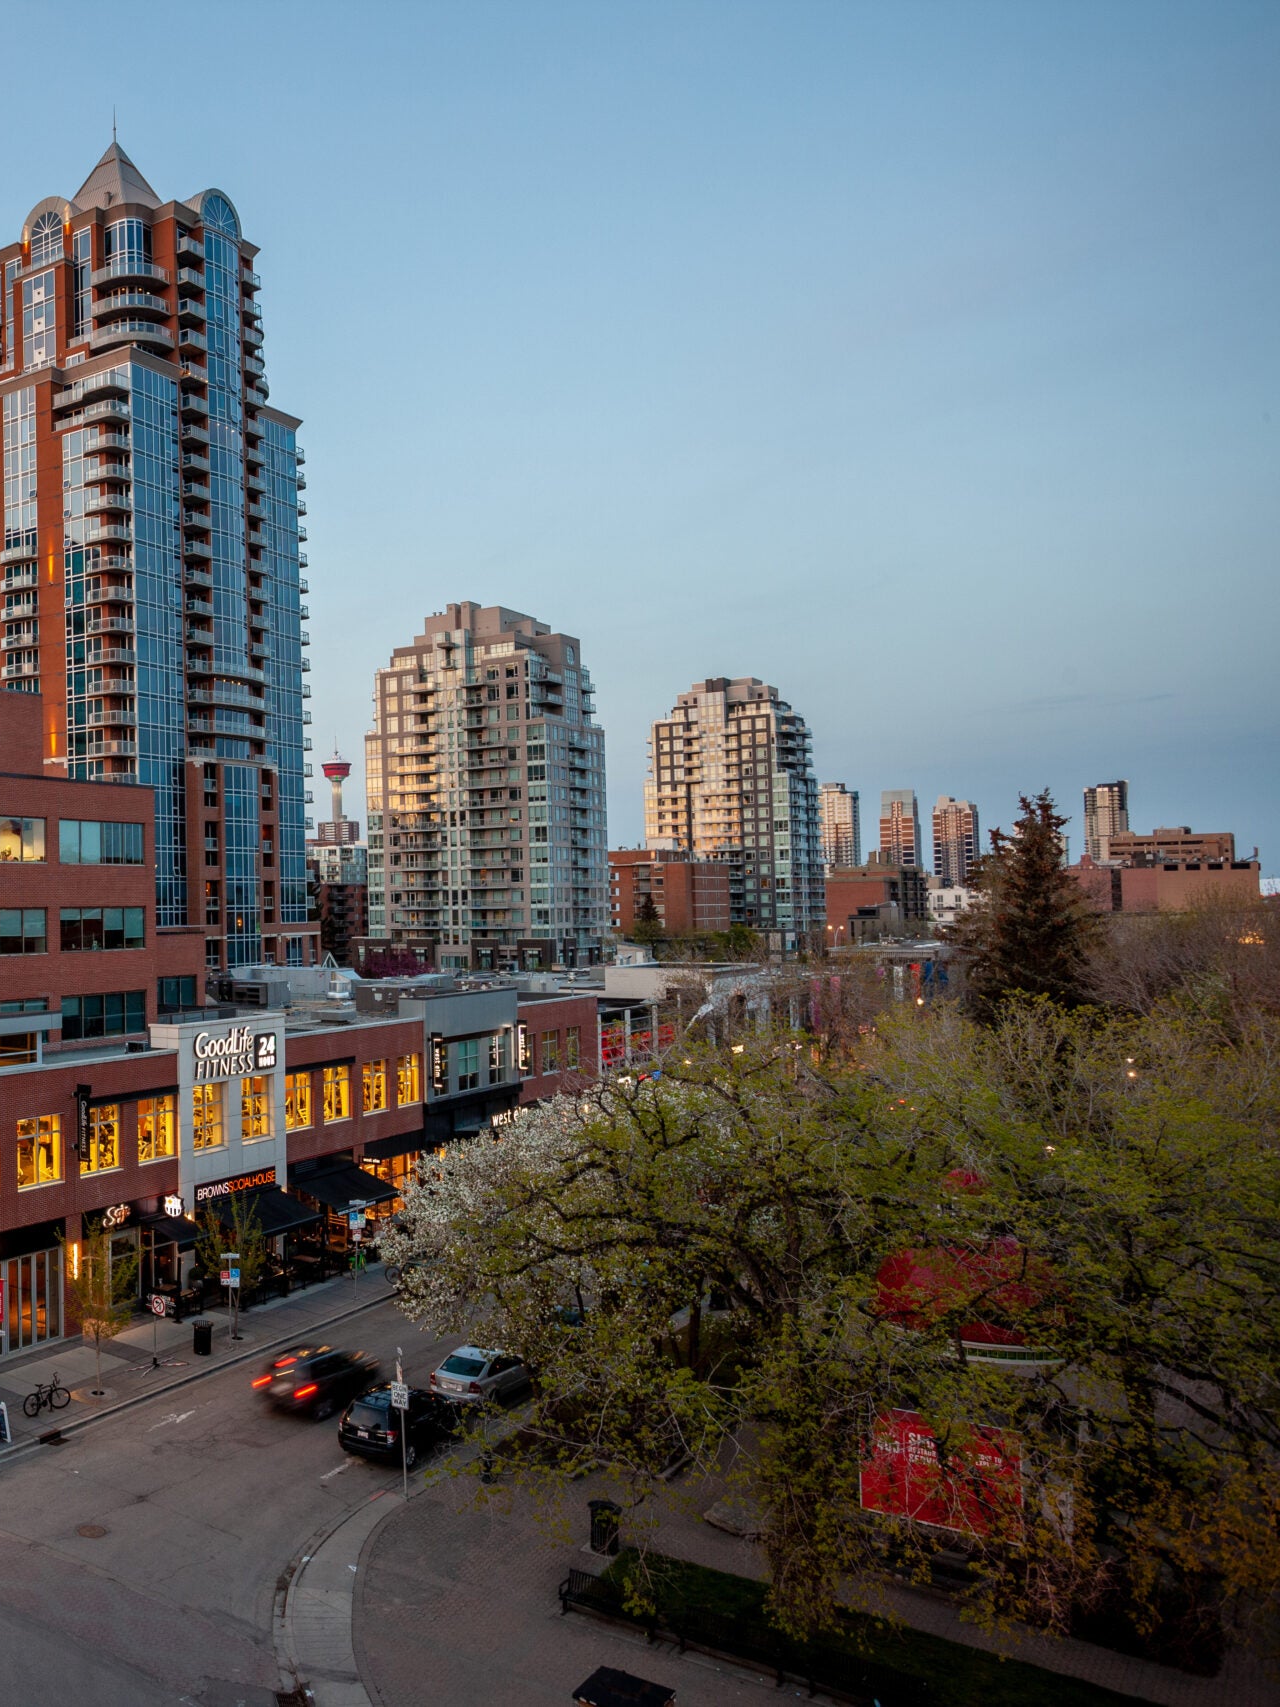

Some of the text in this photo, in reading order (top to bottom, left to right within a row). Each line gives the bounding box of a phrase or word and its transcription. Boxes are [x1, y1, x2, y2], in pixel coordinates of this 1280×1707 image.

[194, 1026, 254, 1059] GoodLife
[258, 1036, 276, 1056] 24
[195, 1054, 254, 1080] FITNESS
[258, 1055, 276, 1068] HOUR
[492, 1108, 512, 1127] west
[393, 1392, 407, 1400] ONE
[393, 1399, 407, 1407] WAY
